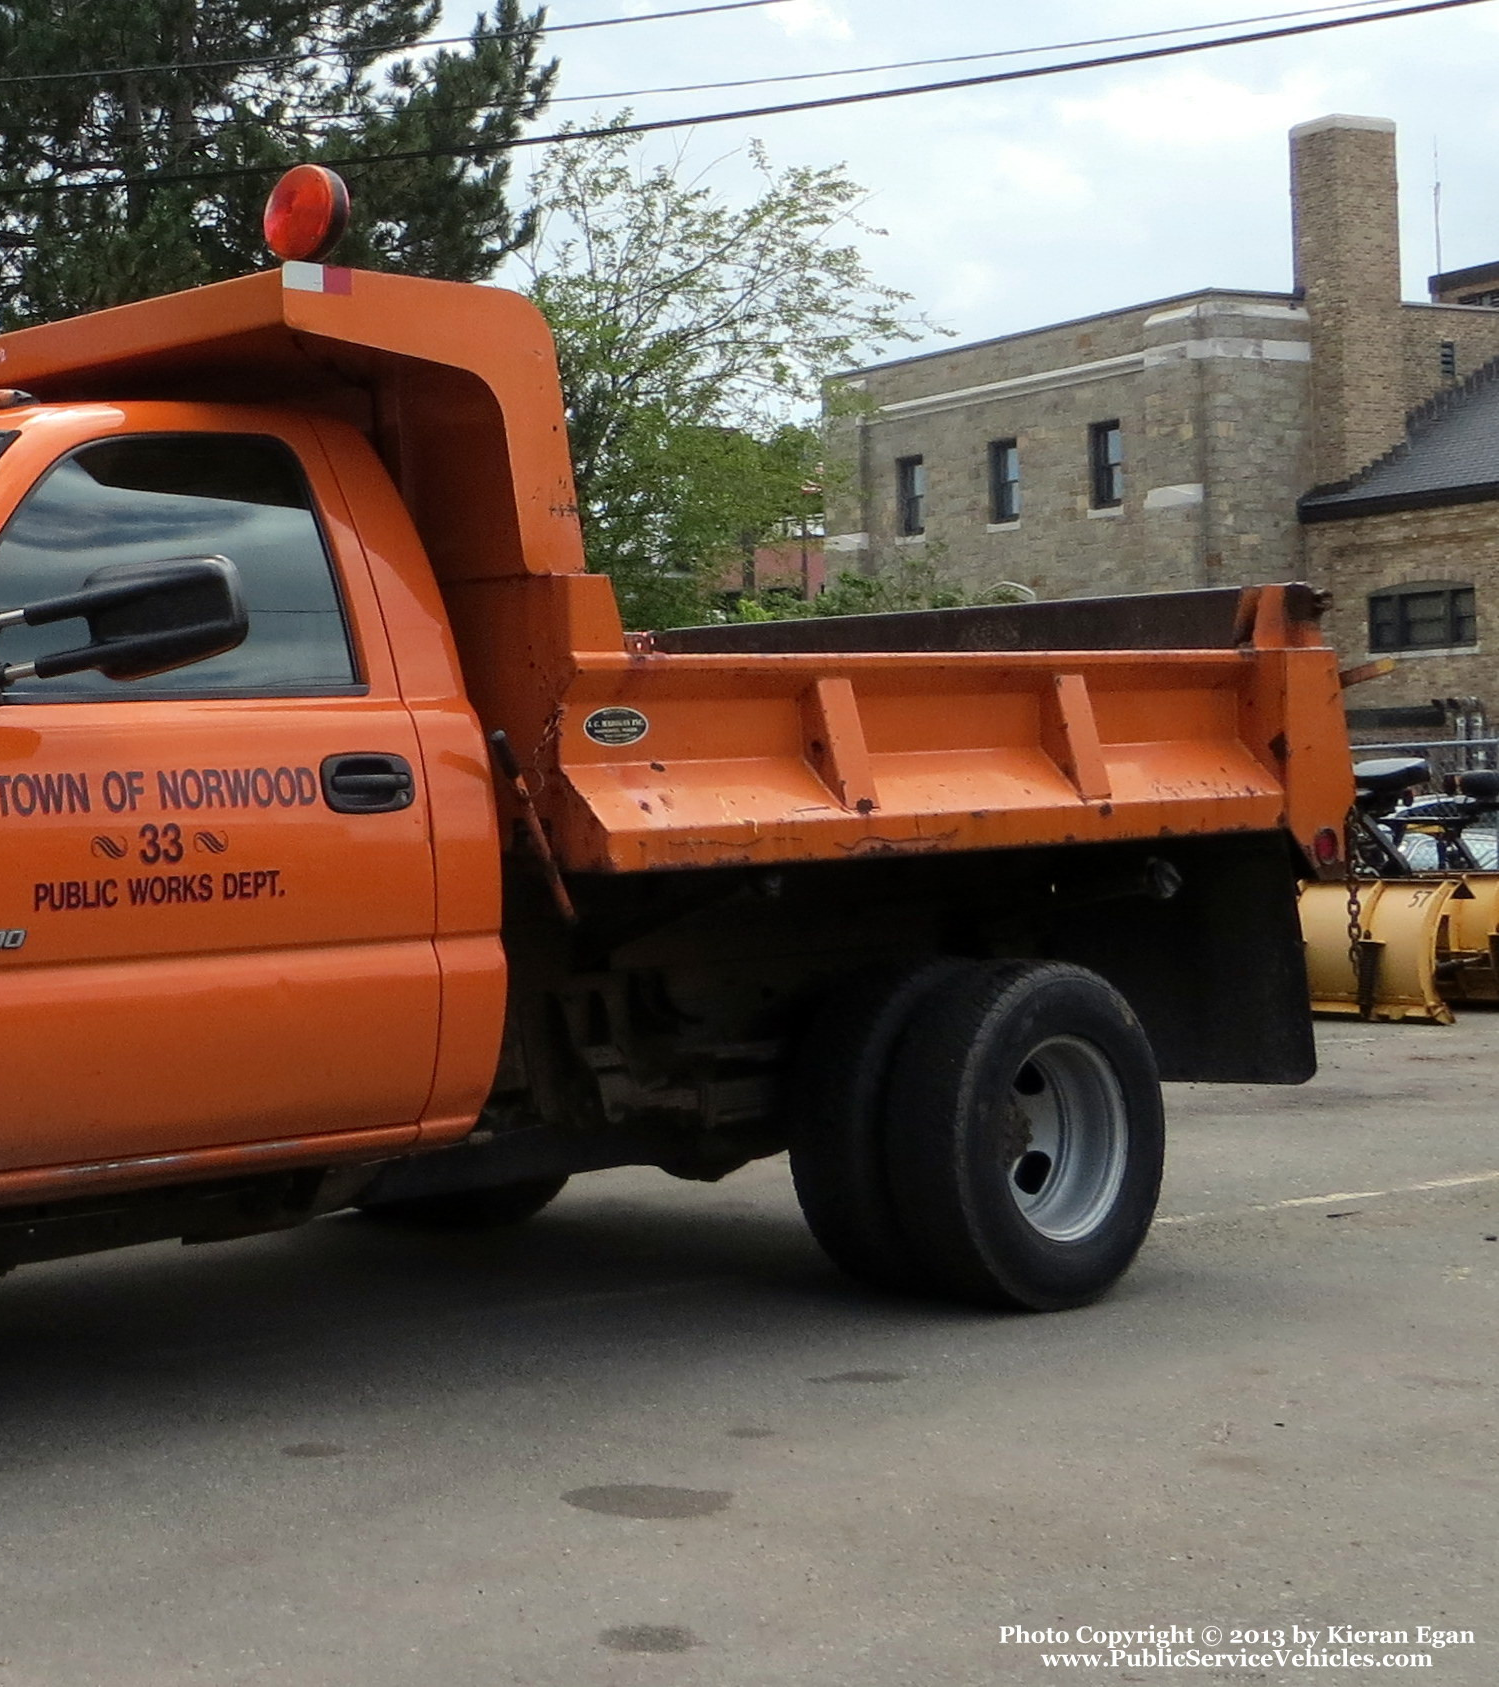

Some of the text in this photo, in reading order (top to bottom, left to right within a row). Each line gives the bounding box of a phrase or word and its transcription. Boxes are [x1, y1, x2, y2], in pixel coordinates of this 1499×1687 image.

[102, 770, 145, 814] OF
[156, 766, 317, 811] NORWOOD
[139, 822, 184, 865] 33
[34, 869, 286, 912] PUBLIC WORKS DEPT.
[1408, 890, 1433, 908] 57
